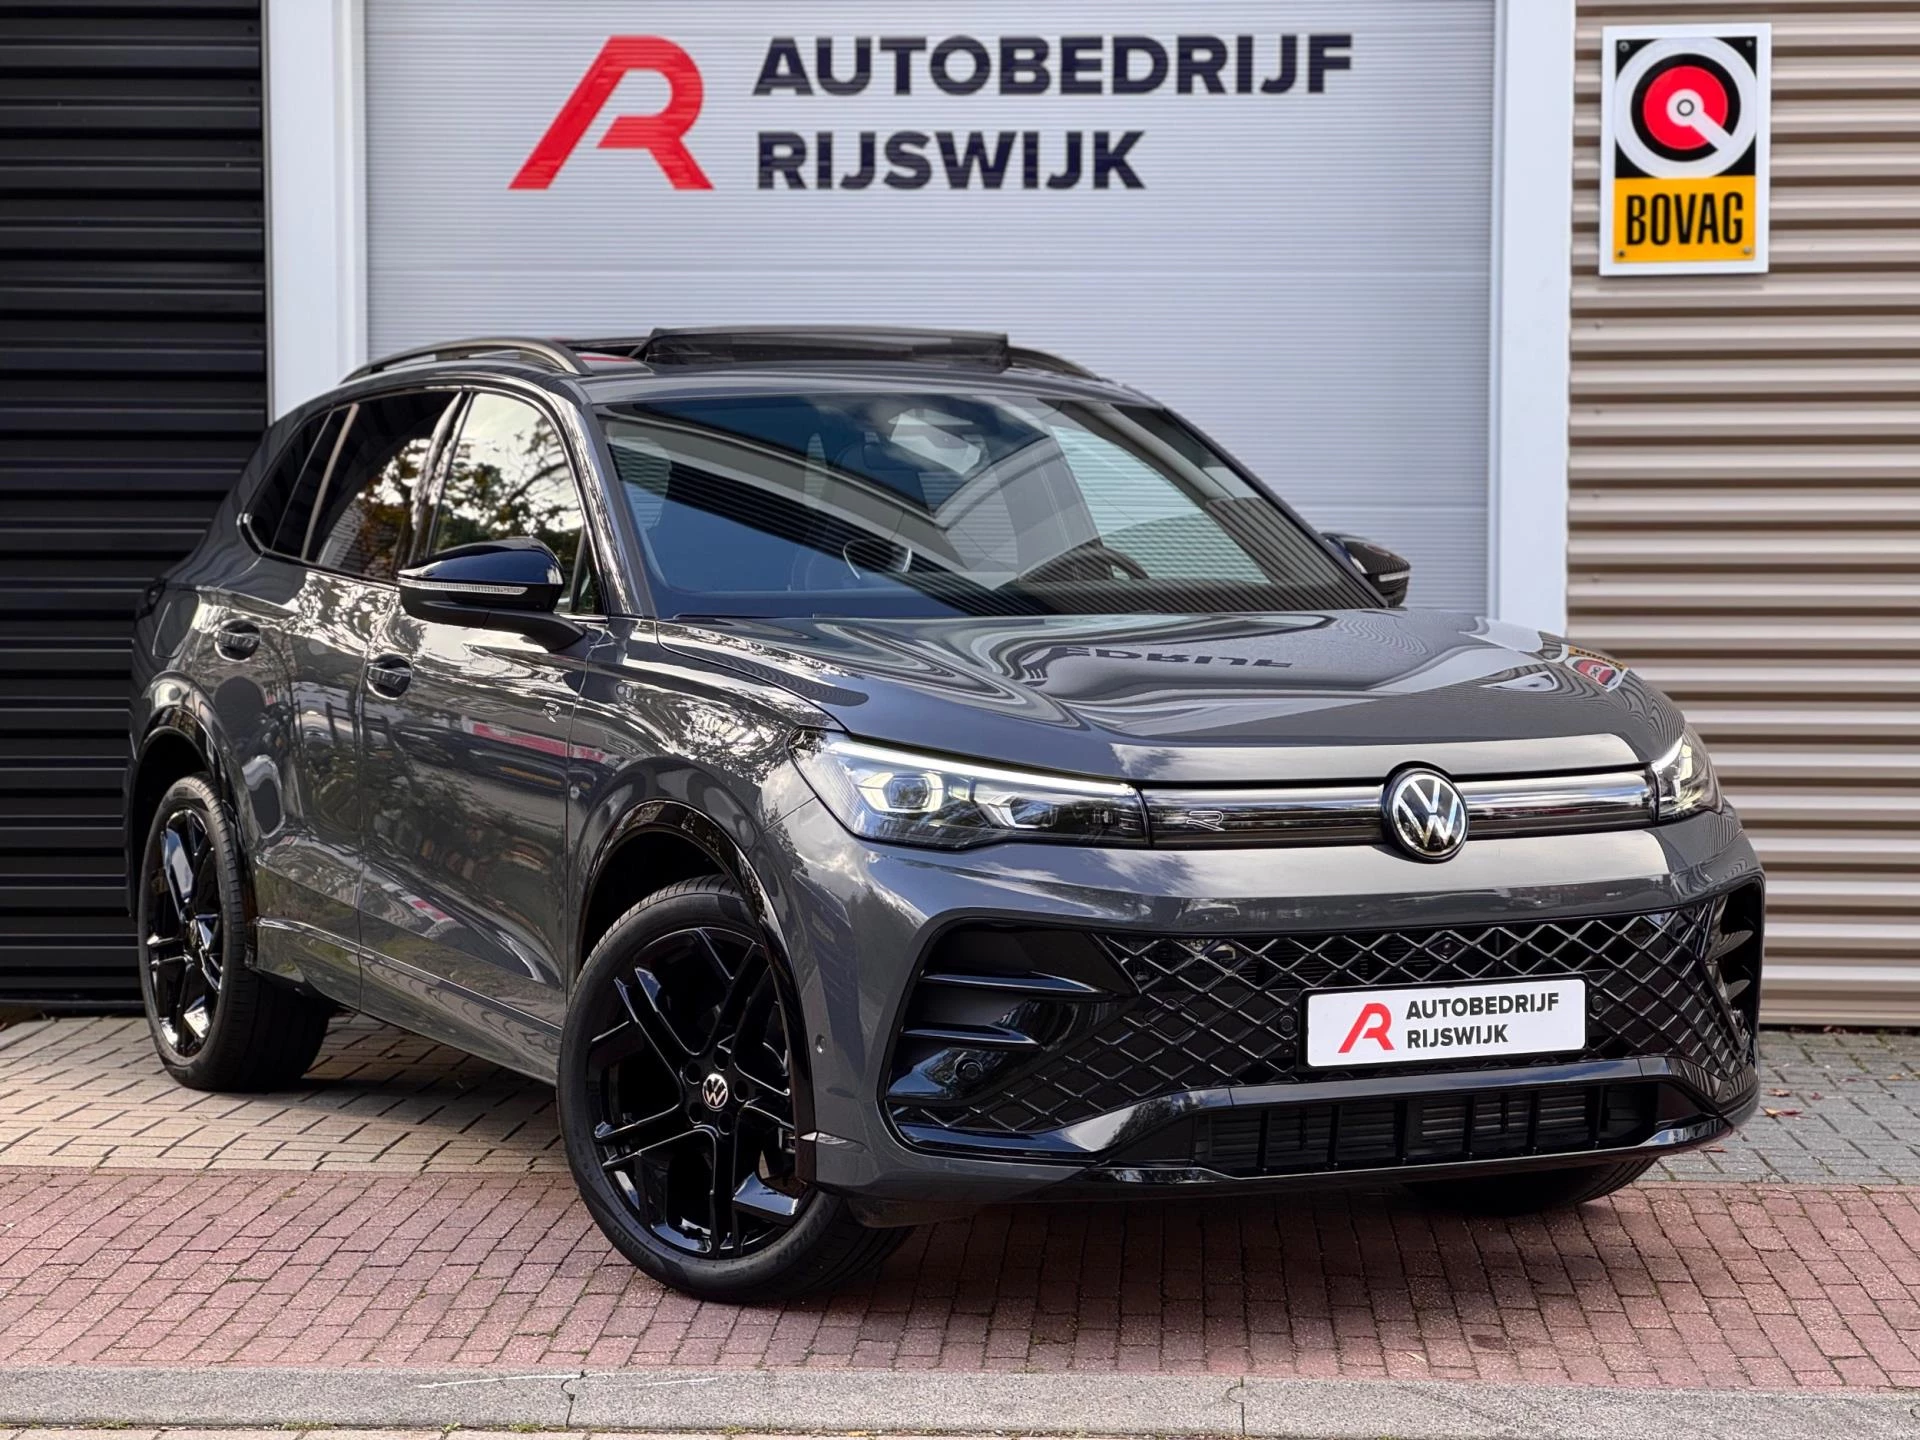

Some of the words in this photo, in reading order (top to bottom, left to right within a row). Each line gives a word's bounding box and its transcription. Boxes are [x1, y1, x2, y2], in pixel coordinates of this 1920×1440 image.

[752, 34, 1353, 96] AUTOBEDRIJF
[757, 131, 1147, 190] RIJSWIJK
[1625, 191, 1744, 246] BOVAG
[1405, 992, 1560, 1020] AUTOBEDRIJF
[1407, 1023, 1509, 1049] RIJSWIJK
